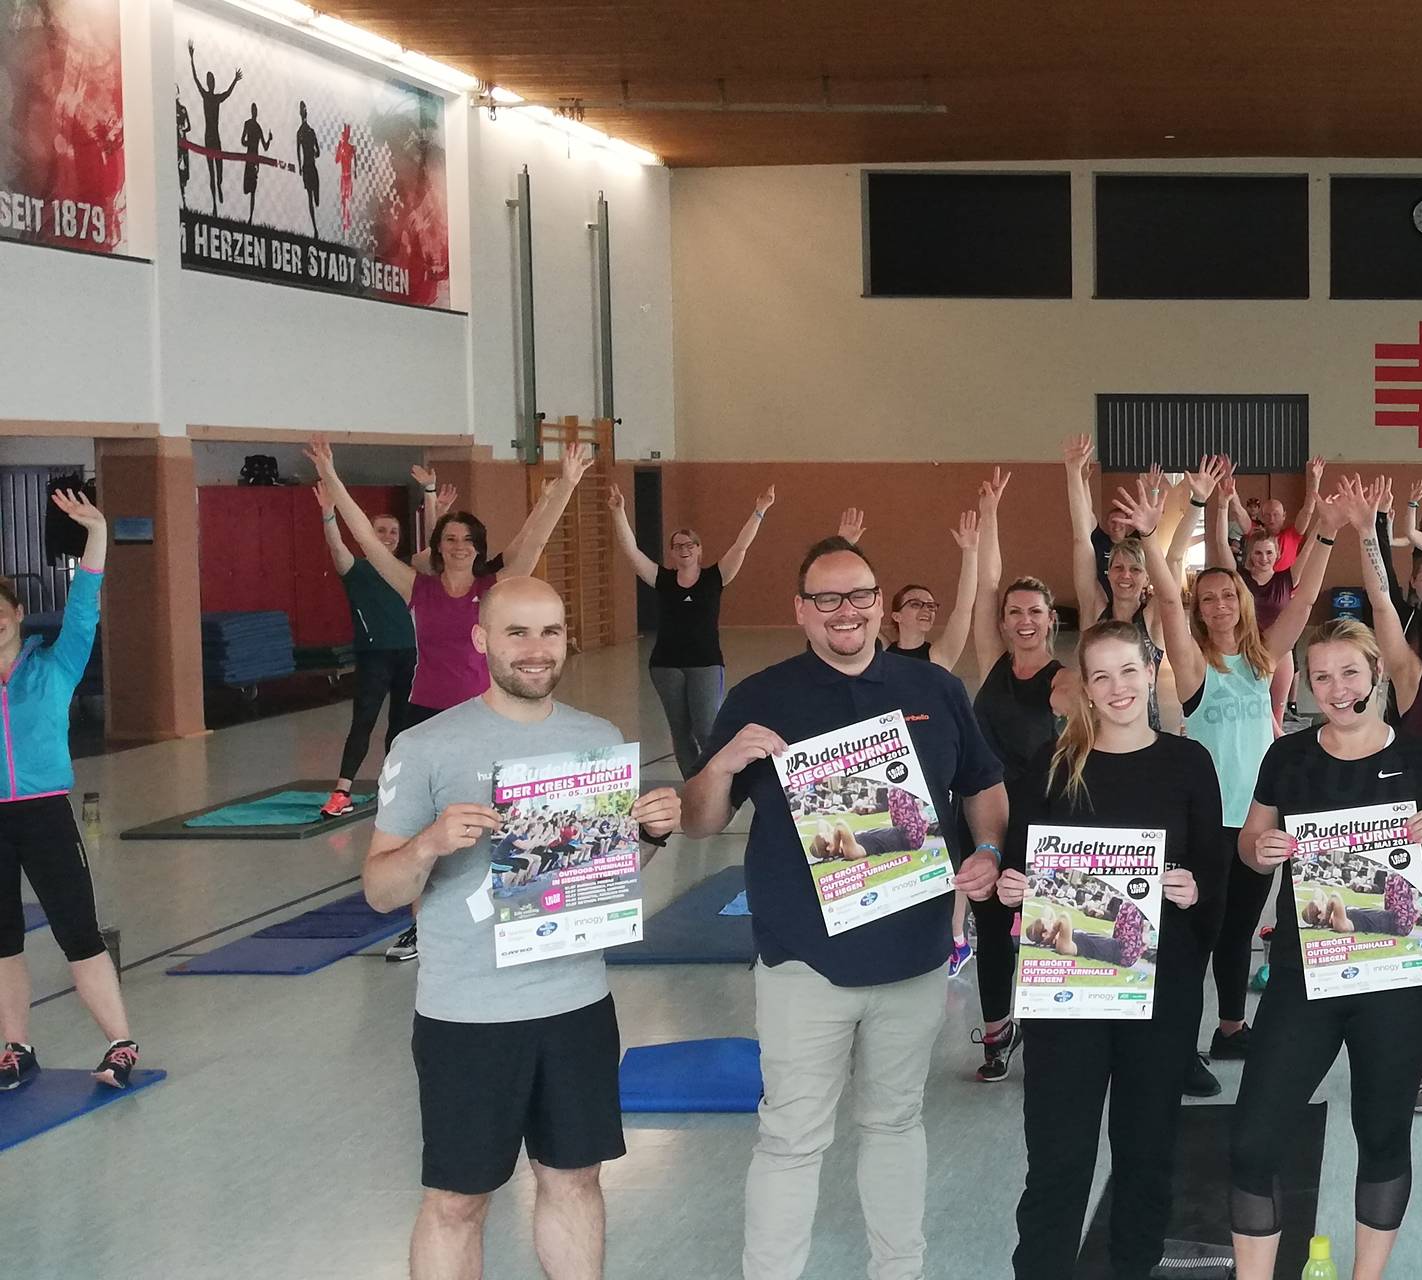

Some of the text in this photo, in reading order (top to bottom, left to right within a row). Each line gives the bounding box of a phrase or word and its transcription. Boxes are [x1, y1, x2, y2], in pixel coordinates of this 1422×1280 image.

[0, 190, 106, 243] SEIT 1879
[195, 222, 266, 269] HERZEN
[272, 242, 302, 274] DER
[307, 246, 356, 283] STADT
[360, 258, 410, 295] SIEGEN
[786, 727, 899, 775] Rudelturnen
[790, 738, 902, 788] SIEGEN TURNT!
[846, 749, 907, 776] AB 7. MAI 2019
[498, 757, 627, 786] Rudelturnen
[502, 767, 627, 799] DER KREIS TURNT!
[586, 786, 605, 794] JULI
[608, 781, 630, 791] 2019
[1296, 817, 1409, 840] Rudelturnen
[1298, 827, 1407, 853] SIEGEN TURNT!
[1034, 836, 1155, 856] Rudelturnen
[1036, 856, 1091, 867] SIEGEN
[1095, 856, 1152, 867] TURNT!
[820, 874, 834, 884] DIE
[822, 856, 908, 892] OUTDOOR-TURNHALLE
[824, 882, 862, 900] IN SIEGEN
[574, 915, 604, 926] innogy
[1307, 940, 1394, 957] OUTDOOR-TURNHALLE
[1318, 954, 1346, 963] SIEGEN
